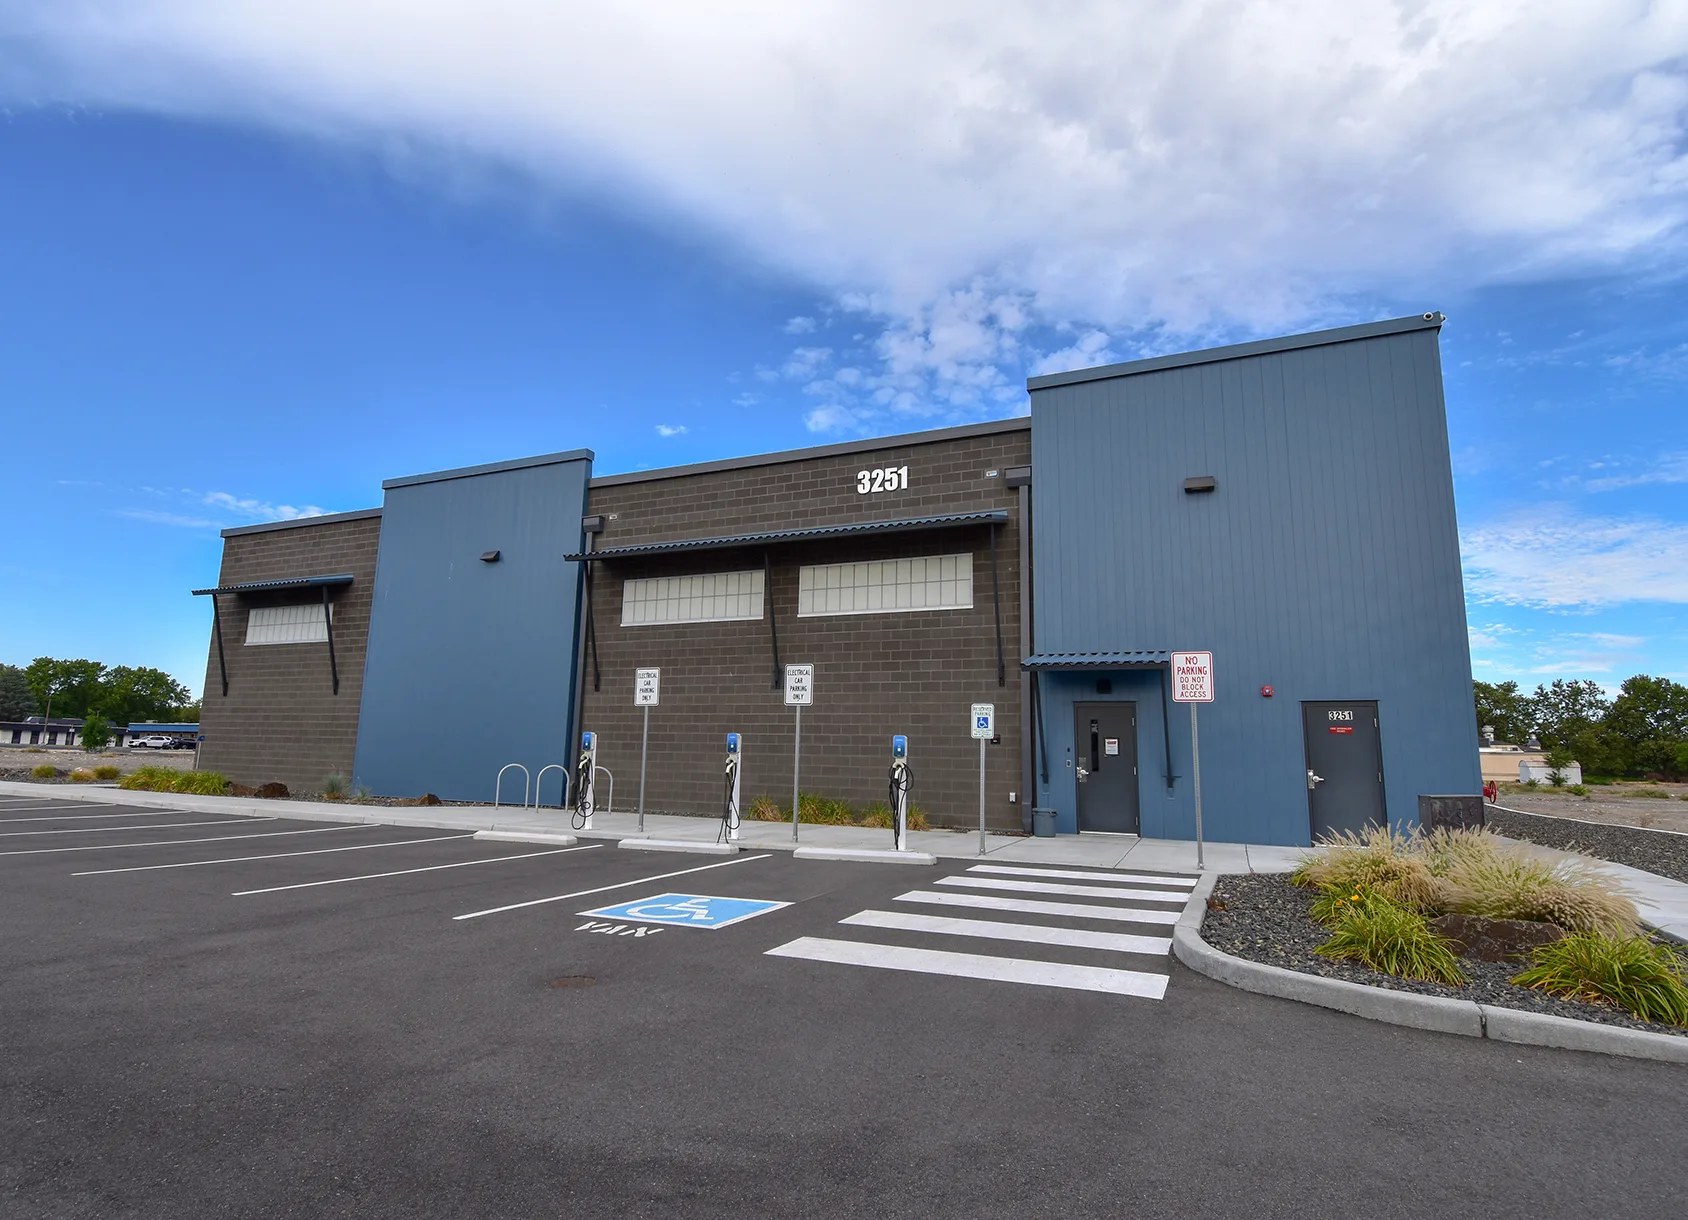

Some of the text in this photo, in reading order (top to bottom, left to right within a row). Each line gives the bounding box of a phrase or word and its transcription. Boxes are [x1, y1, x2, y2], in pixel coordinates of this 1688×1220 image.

[857, 465, 908, 494] 3251
[1185, 656, 1198, 665] NO
[1177, 666, 1207, 675] PARKING
[1329, 711, 1352, 720] 3251
[573, 921, 665, 938] VAN
